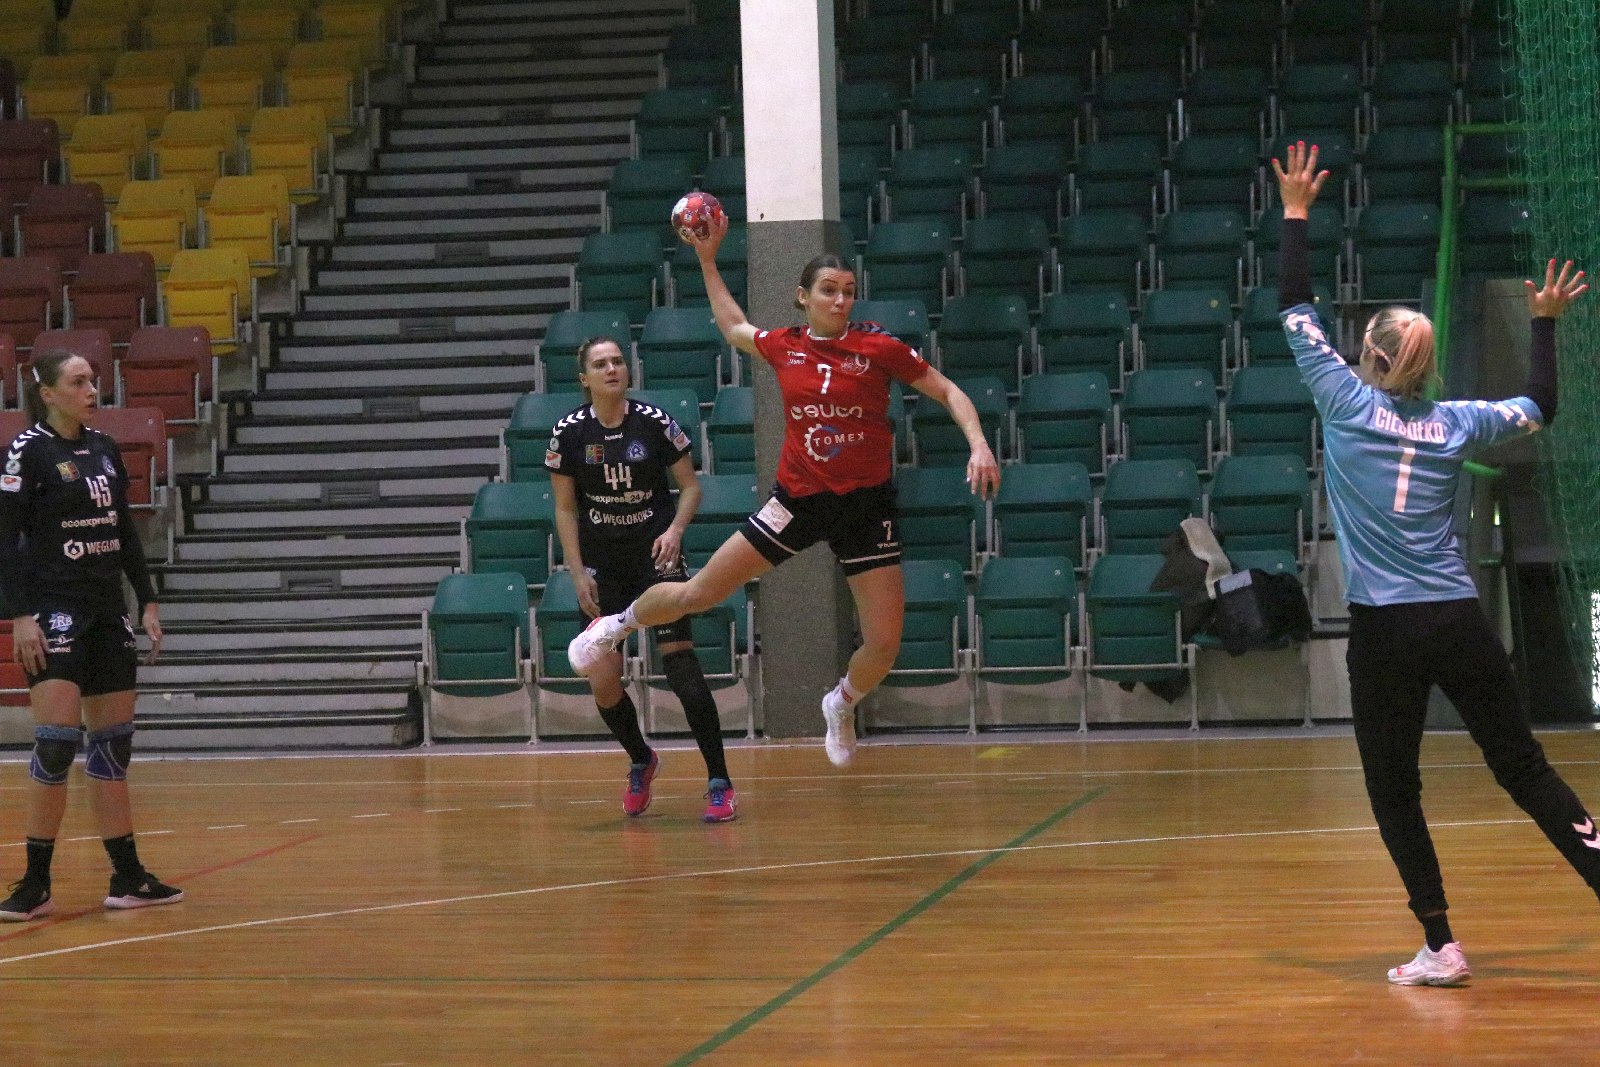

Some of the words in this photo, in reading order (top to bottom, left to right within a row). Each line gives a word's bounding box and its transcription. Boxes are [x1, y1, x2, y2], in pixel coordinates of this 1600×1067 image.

[817, 363, 832, 394] 7
[813, 432, 865, 447] TOMEX
[85, 474, 112, 507] 45
[604, 463, 632, 490] 44
[1393, 440, 1416, 512] 1
[882, 520, 892, 541] 7
